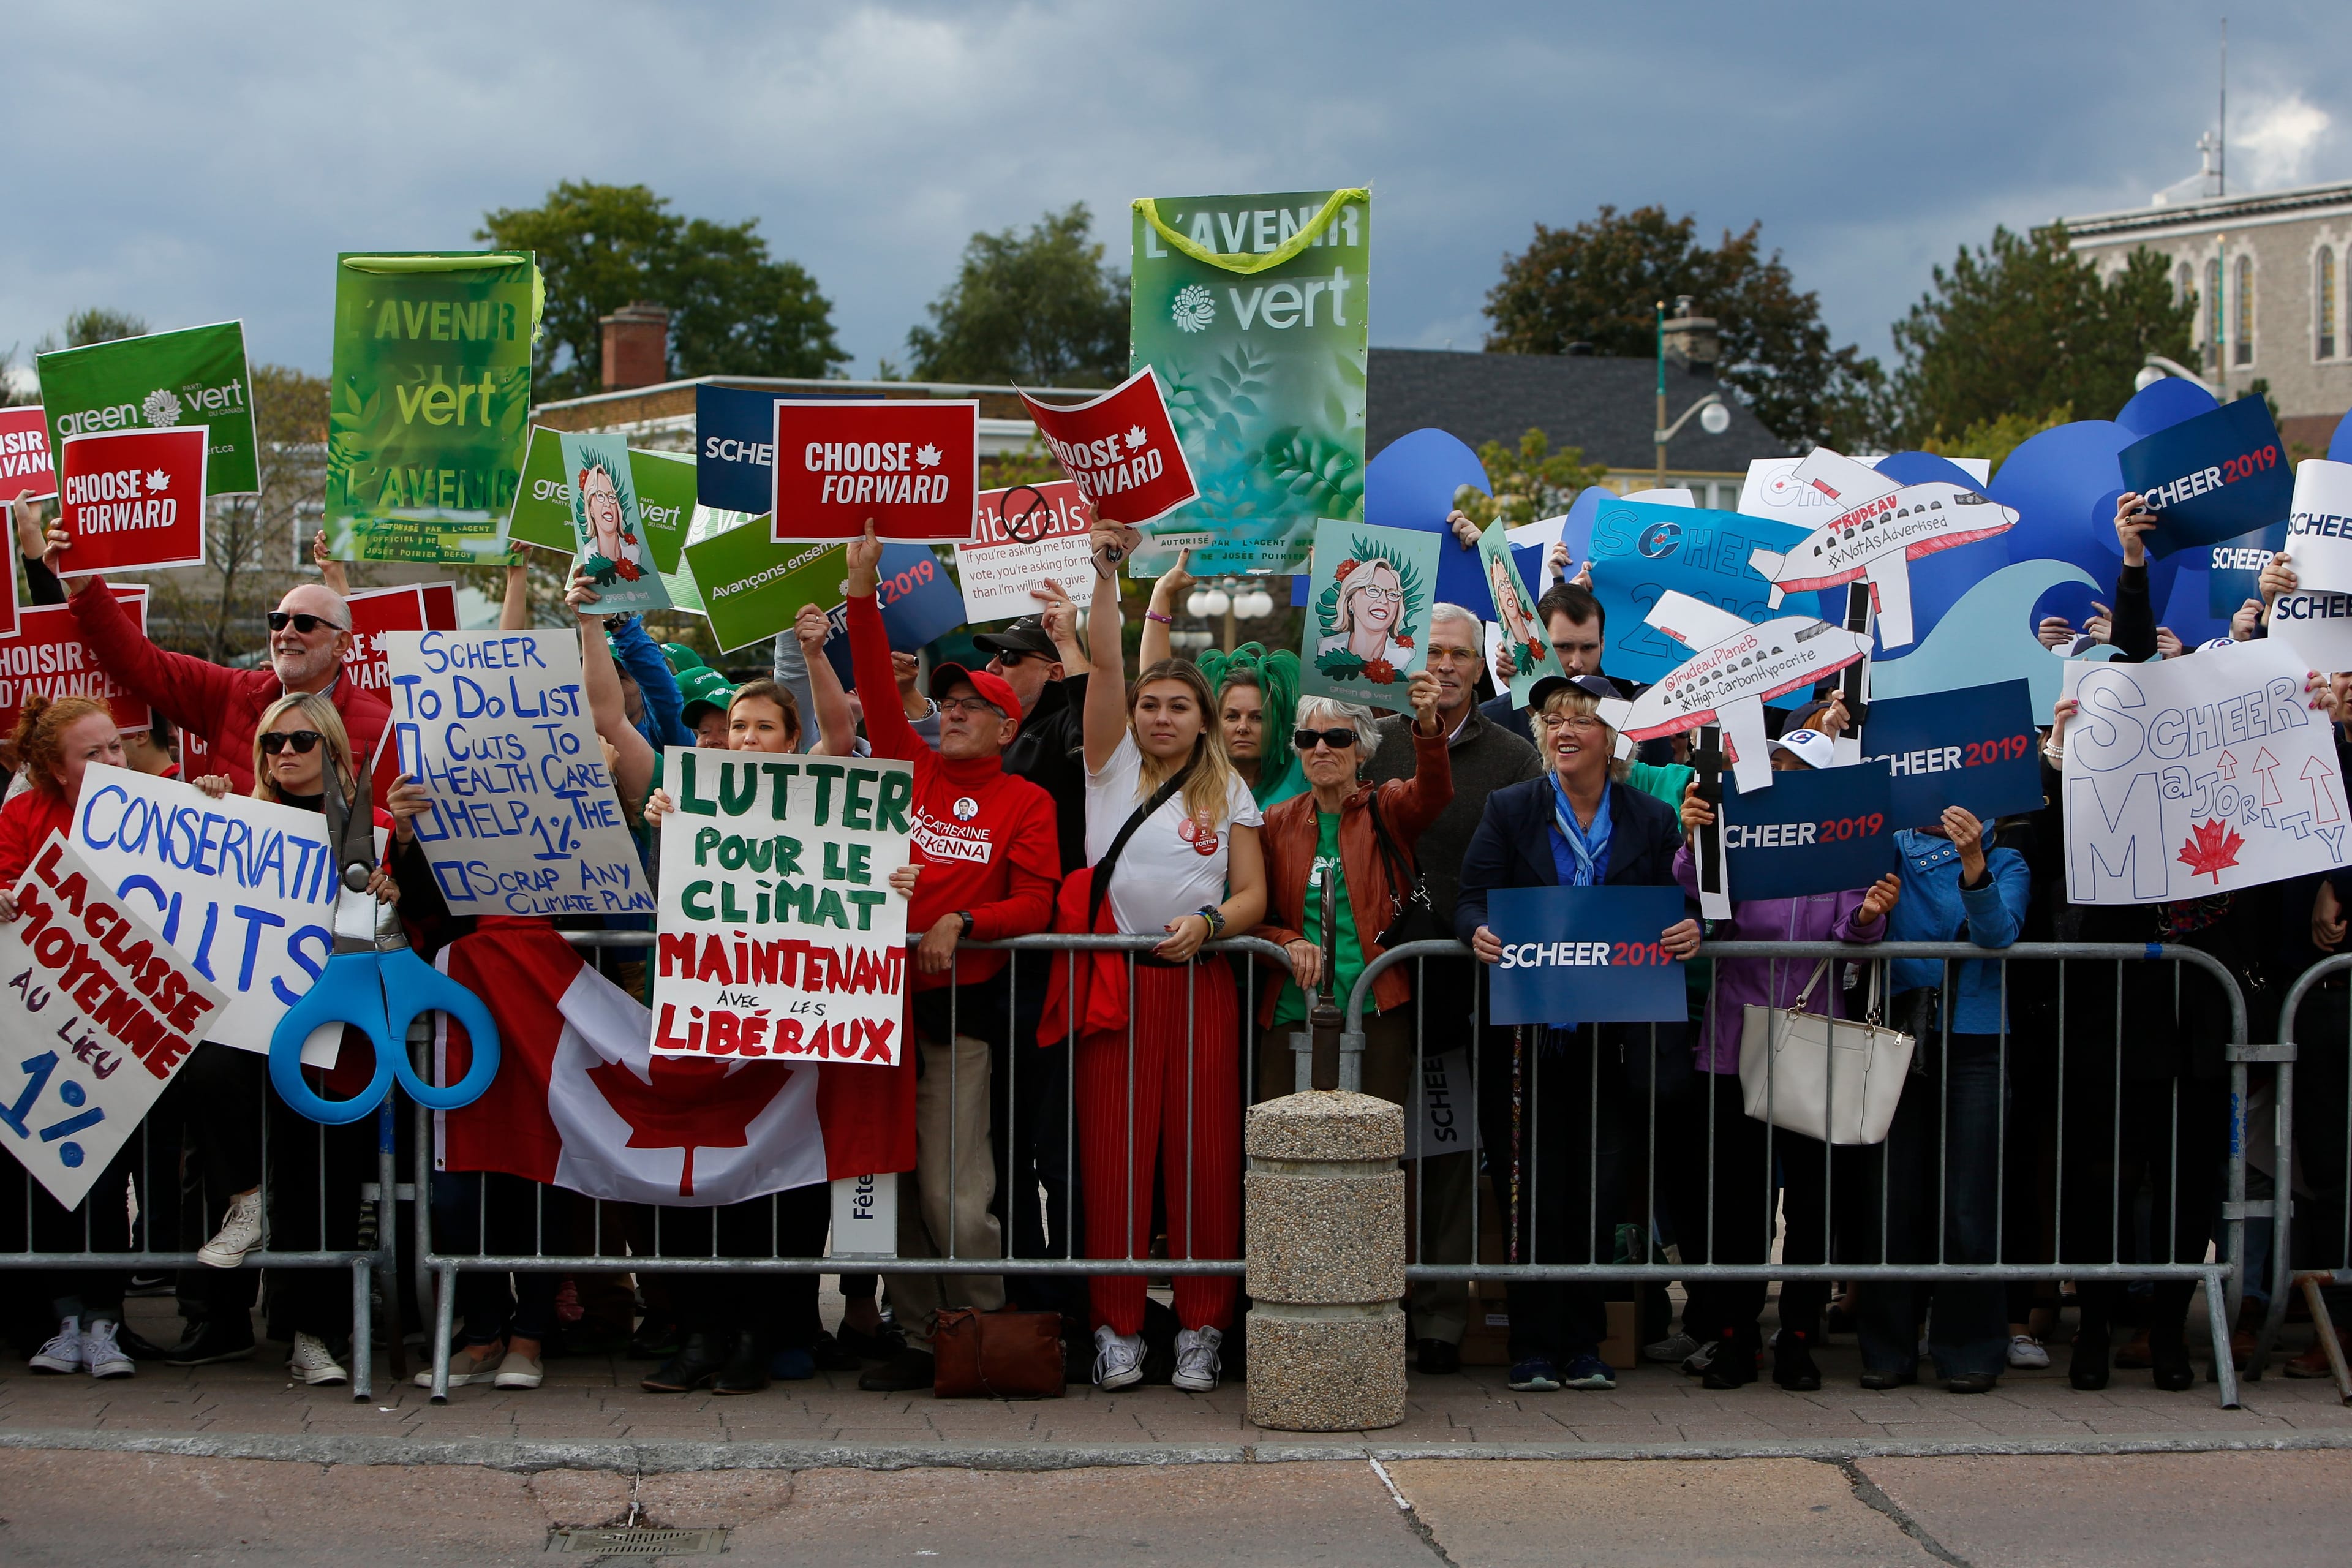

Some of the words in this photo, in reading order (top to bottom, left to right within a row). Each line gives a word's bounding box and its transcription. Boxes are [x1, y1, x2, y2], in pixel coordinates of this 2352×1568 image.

[1229, 266, 1350, 331] vert
[341, 300, 516, 341] L'AVENIR
[183, 383, 202, 392] PARTI
[185, 378, 244, 412] vert
[396, 372, 496, 427] vert
[57, 403, 138, 437] green
[219, 407, 244, 416] CANADA
[705, 436, 773, 467] SCHE
[805, 442, 911, 472] CHOOSE
[2223, 445, 2277, 484] 2019
[66, 469, 141, 505] CHOOSE
[344, 467, 519, 509] L'AVENIR
[533, 478, 570, 501] gre
[821, 475, 949, 504] FORWARD
[78, 498, 177, 535] FORWARD
[639, 503, 681, 526] vert
[655, 522, 676, 532] CANADA
[967, 497, 1085, 545] iberals
[1828, 494, 1897, 535] TRUDEAU
[2288, 512, 2352, 540] SCHEE
[366, 546, 394, 556] JOSÉE
[400, 549, 437, 558] POIRIER
[444, 550, 471, 559] DEFOY
[966, 551, 974, 564] If
[975, 548, 1007, 564] you're
[1009, 541, 1042, 559] asking
[1043, 540, 1060, 551] me
[1061, 538, 1076, 550] for
[1077, 537, 1092, 549] my
[1161, 534, 1209, 547] AUTORISÉ
[1222, 549, 1254, 560] JOSÉE
[1262, 552, 1306, 560] POIRIER
[1828, 514, 1948, 571] #NotAsAdvertised
[2211, 546, 2274, 571] SCHEER
[712, 562, 786, 601] Avançons
[788, 541, 841, 571] ensem
[881, 560, 935, 605] 2019
[969, 567, 996, 581] vote,
[997, 564, 1028, 581] you're
[1030, 557, 1063, 575] asking
[1064, 554, 1078, 568] for
[605, 591, 627, 603] green
[973, 586, 997, 599] than
[999, 582, 1015, 595] I'm
[1016, 577, 1051, 594] willing
[1065, 573, 1088, 589] give.
[2275, 594, 2352, 620] SCHEE
[0, 641, 85, 677] HOISIR
[420, 631, 546, 673] SCHEER
[1664, 634, 1758, 692] @TrudeauPlaneB
[0, 670, 133, 709] D'AVANCE
[694, 671, 715, 684] green
[1329, 685, 1358, 699] green
[1681, 649, 1817, 712] #High-CarbonHypocrite
[509, 676, 579, 718] LIST
[1373, 691, 1393, 701] vert
[2073, 668, 2309, 772] SCHEER
[425, 752, 539, 796] HEALTH
[541, 753, 610, 793] CARE
[1861, 747, 1962, 778] HEER
[1964, 734, 2028, 767] 2019
[680, 752, 913, 835] LUTTER
[447, 798, 530, 839] HELP
[554, 790, 621, 831] THE
[922, 814, 991, 840] CATHERINE
[1724, 822, 1817, 848] CHEER
[1819, 812, 1885, 843] 2019
[530, 814, 581, 861] 1%
[695, 826, 805, 876] POUR
[823, 840, 872, 885] LE
[910, 820, 986, 860] McKENNA
[1195, 838, 1218, 848] FORTIER
[466, 861, 560, 896] SCRAP
[580, 859, 631, 891] ANY
[505, 892, 596, 914] CLIMATE
[600, 890, 657, 911] PLAN
[34, 842, 88, 918] LA
[84, 902, 214, 1036] CLASSE
[1499, 941, 1610, 970] SCHEER
[1611, 942, 1675, 967] 2019
[9, 967, 51, 1012] AU
[13, 881, 192, 1080] MOYENNE
[716, 990, 760, 1008] AVEC
[790, 1000, 827, 1017] LES
[0, 1050, 106, 1169] 1%
[1422, 1058, 1458, 1142] SCHEE
